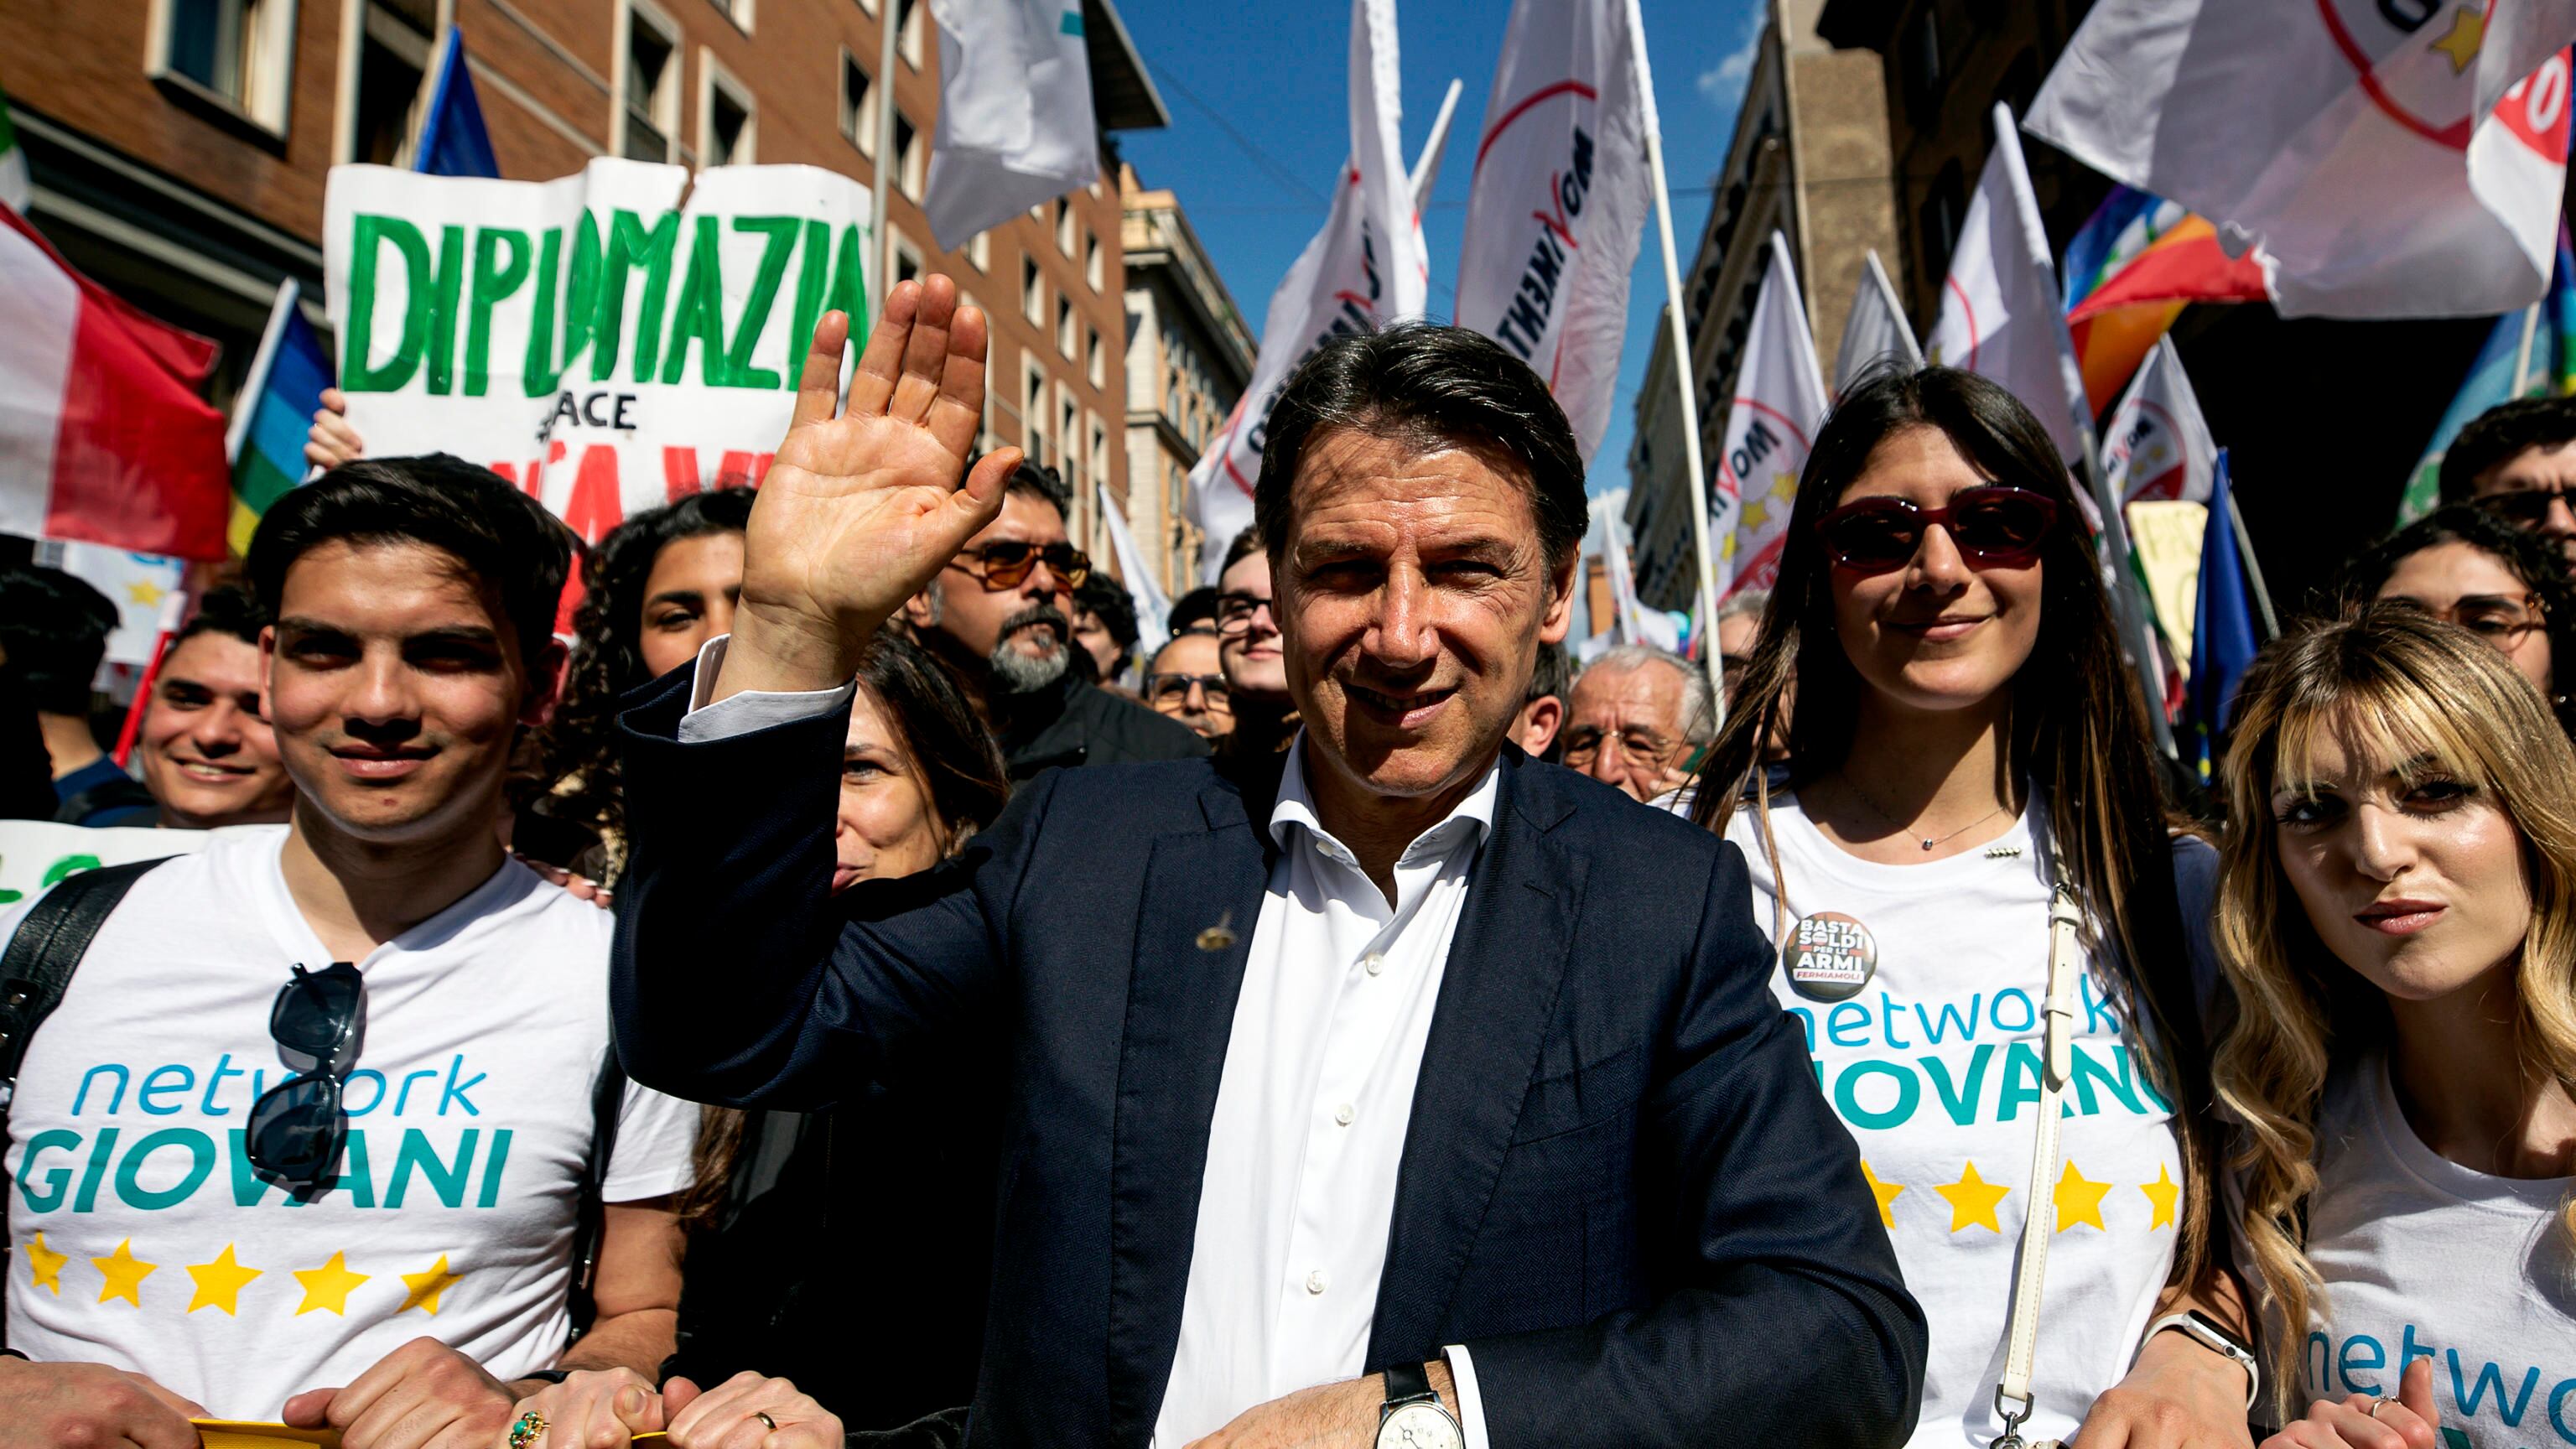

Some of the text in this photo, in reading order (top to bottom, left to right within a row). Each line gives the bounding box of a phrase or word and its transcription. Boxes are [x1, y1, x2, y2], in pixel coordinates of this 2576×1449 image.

[1800, 919, 1863, 936] BASTA
[1813, 945, 1849, 956] PER LE
[1796, 952, 1862, 970] ARMI
[1797, 971, 1861, 980] FERMIAMOLI
[1784, 974, 2120, 1052] netwok
[2308, 1325, 2576, 1446] netwo
